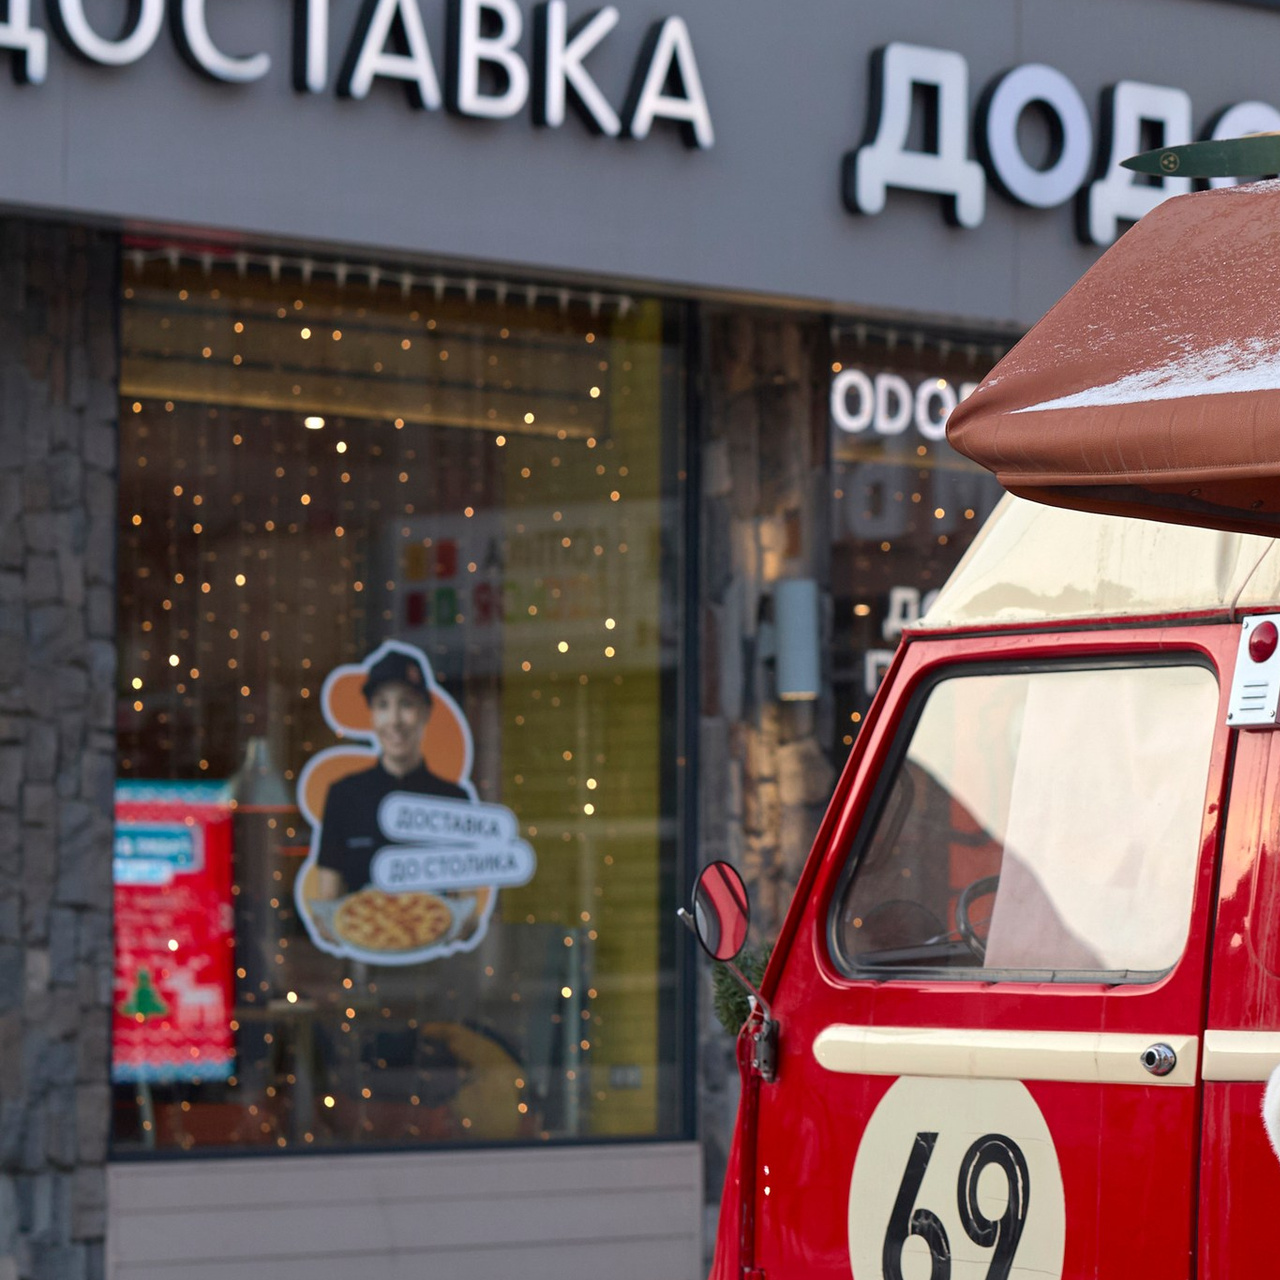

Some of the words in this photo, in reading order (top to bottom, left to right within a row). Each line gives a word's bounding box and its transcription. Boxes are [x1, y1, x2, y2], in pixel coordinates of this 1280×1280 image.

[831, 368, 978, 441] ODO
[396, 806, 501, 837] ДОСТАВКА
[389, 857, 420, 884] ДО
